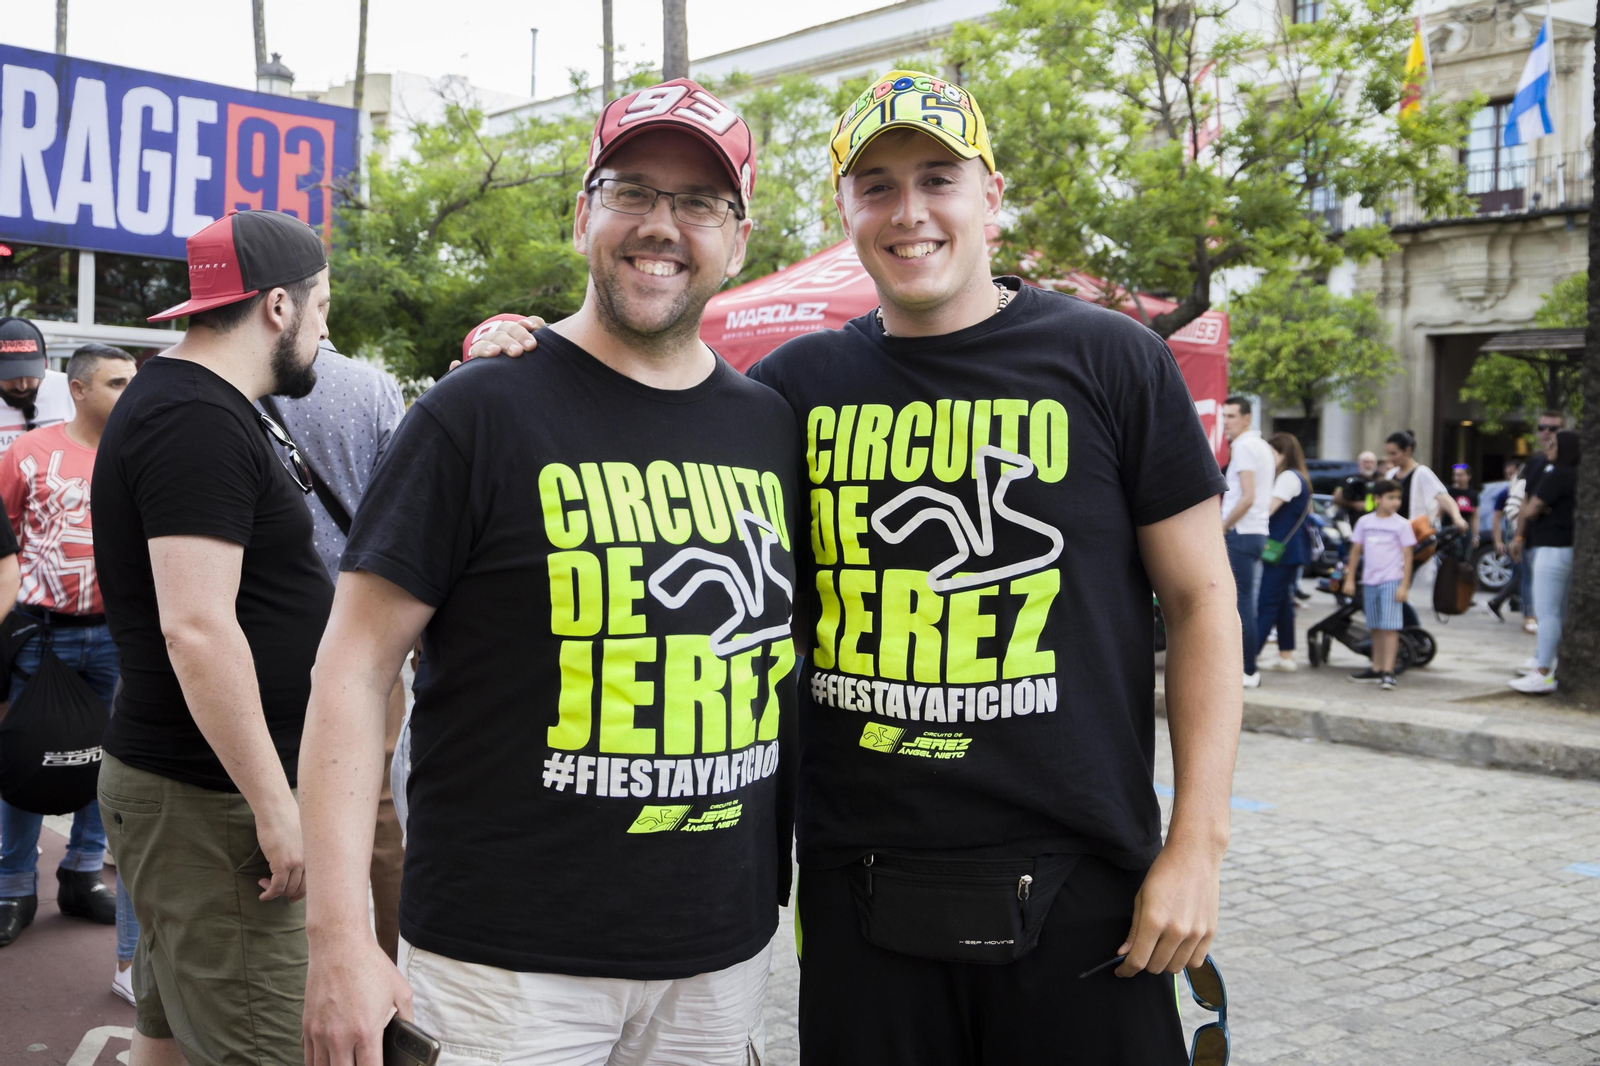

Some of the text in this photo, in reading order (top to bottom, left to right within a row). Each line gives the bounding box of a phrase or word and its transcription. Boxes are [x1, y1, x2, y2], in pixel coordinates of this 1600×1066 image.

[617, 85, 739, 136] 93
[873, 77, 973, 113] DOCTOR
[236, 116, 326, 224] 93
[725, 302, 829, 330] MARQUEZ
[806, 399, 1069, 484] CIRCUITO
[538, 460, 791, 552] CIRCUITO
[810, 486, 870, 565] DE
[547, 547, 647, 636] DE
[813, 568, 1061, 684] JEREZ
[547, 634, 796, 755] JEREZ
[810, 671, 1057, 723] #FIESTAYAFICIÓN
[542, 739, 780, 798] #FIESTAYAFICIÓ
[902, 736, 973, 751] JEREZ
[934, 751, 966, 759] NIETO
[687, 804, 743, 823] JEREZ
